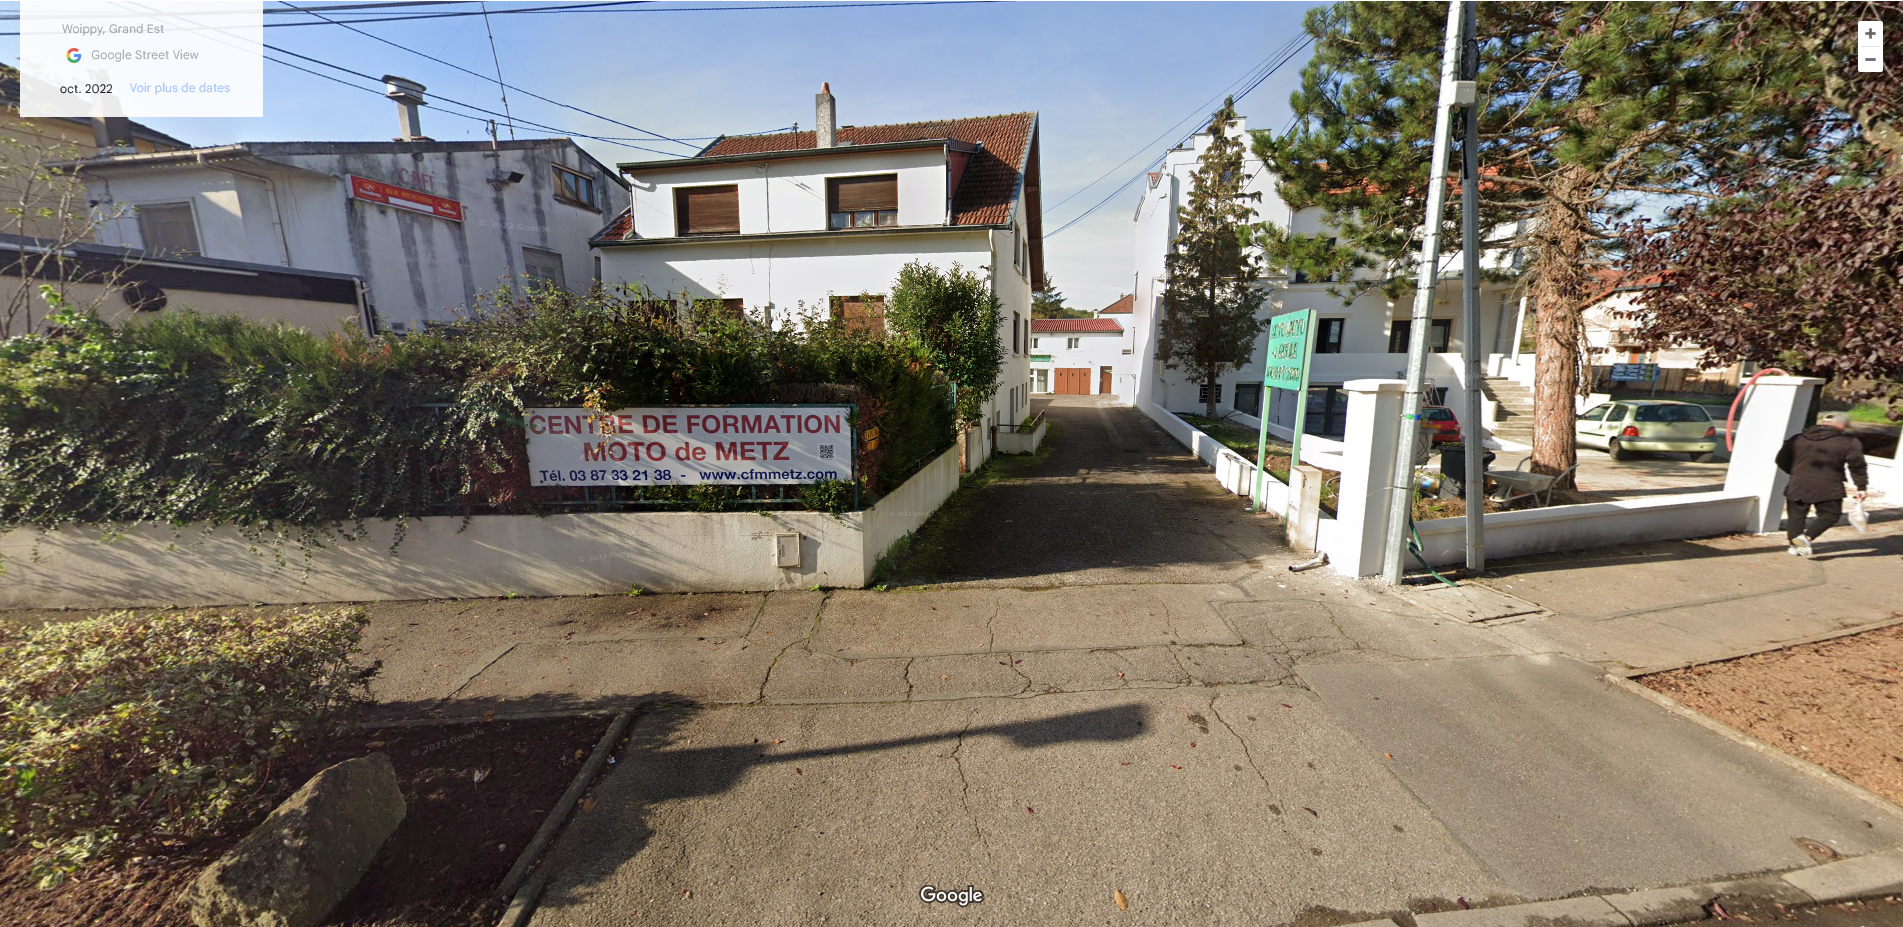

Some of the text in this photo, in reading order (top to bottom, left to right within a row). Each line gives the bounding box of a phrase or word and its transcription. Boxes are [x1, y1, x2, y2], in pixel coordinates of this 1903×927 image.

[529, 414, 841, 435] CENTRE DE FORMATION
[583, 441, 790, 462] MOTO de METZ
[540, 470, 566, 482] Tél.
[569, 470, 586, 481] 03
[590, 470, 607, 481] 87
[611, 470, 628, 481] 33
[633, 470, 648, 481] 21
[654, 469, 672, 481] 38
[699, 469, 838, 480] www.cfmmetz.com
